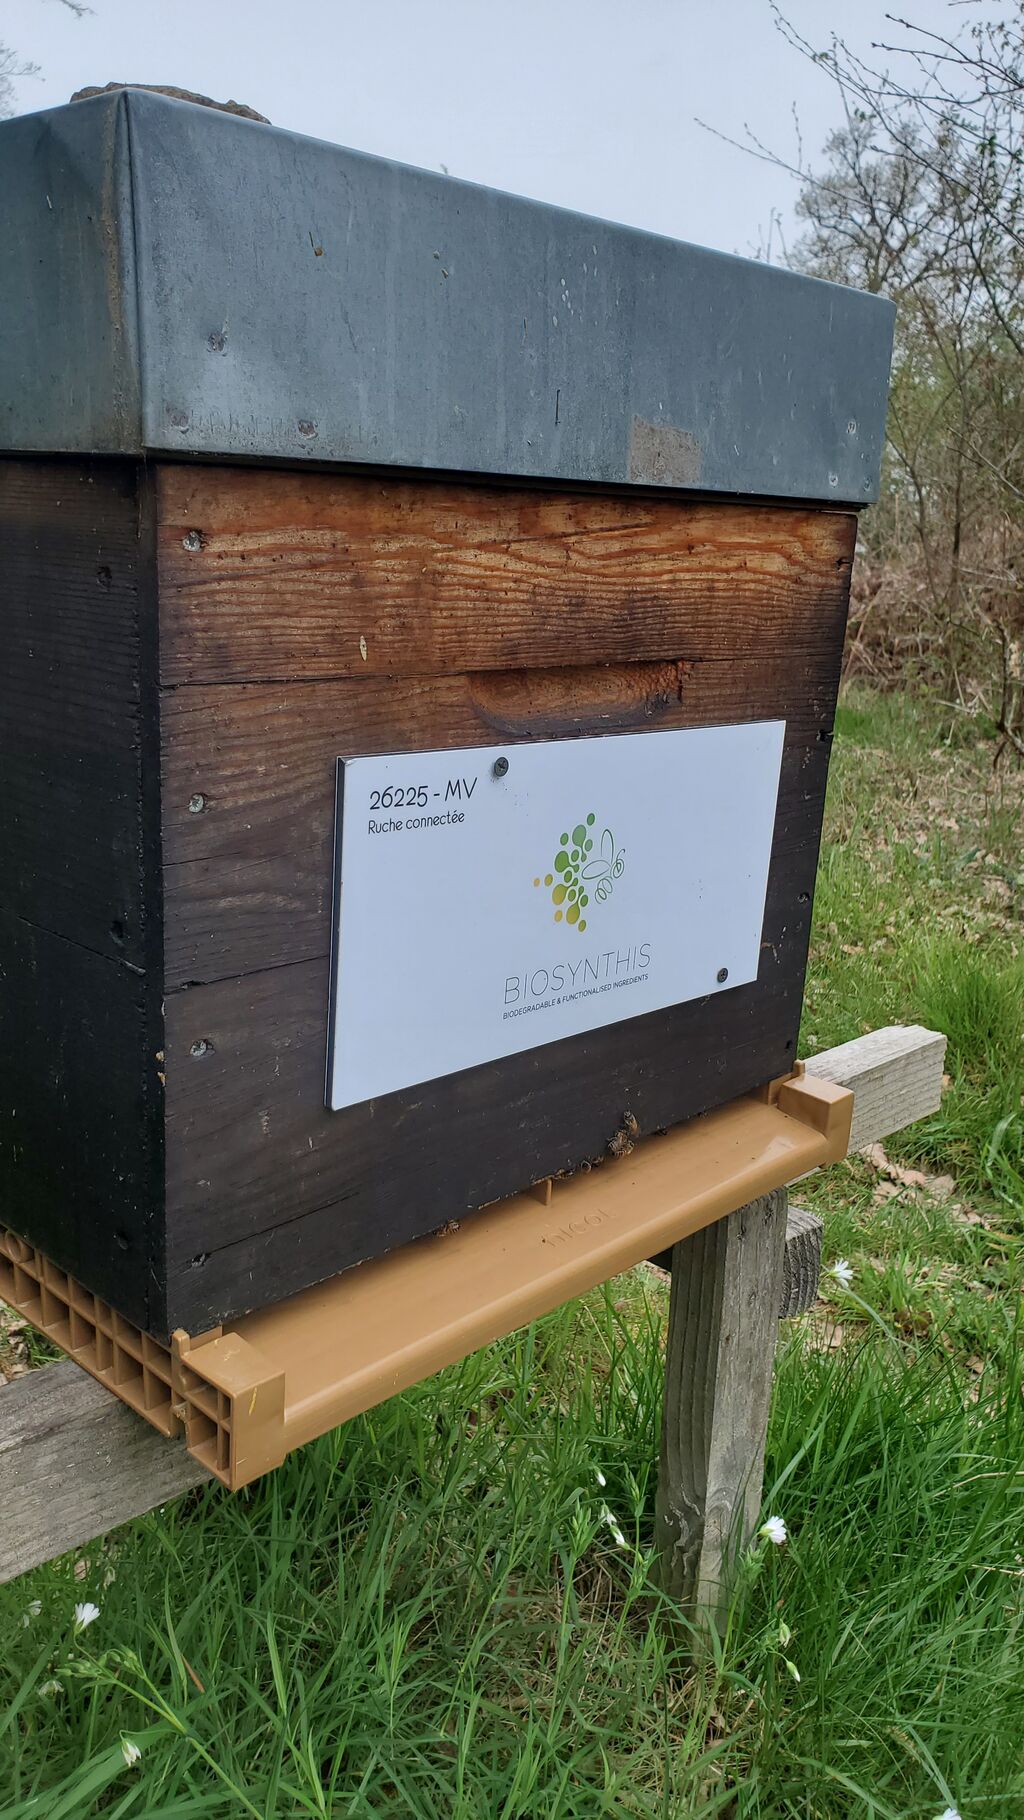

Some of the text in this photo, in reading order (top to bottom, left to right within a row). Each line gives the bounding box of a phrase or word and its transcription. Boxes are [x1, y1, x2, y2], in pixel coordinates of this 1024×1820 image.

[369, 785, 429, 810] 26225
[444, 777, 478, 802] MV
[368, 809, 465, 835] Ruche connectée
[504, 943, 651, 1005] BIOSYNTHIS
[502, 973, 649, 1020] BIODEGRADABLE & FUNCTIONALISED INGREDIENTS
